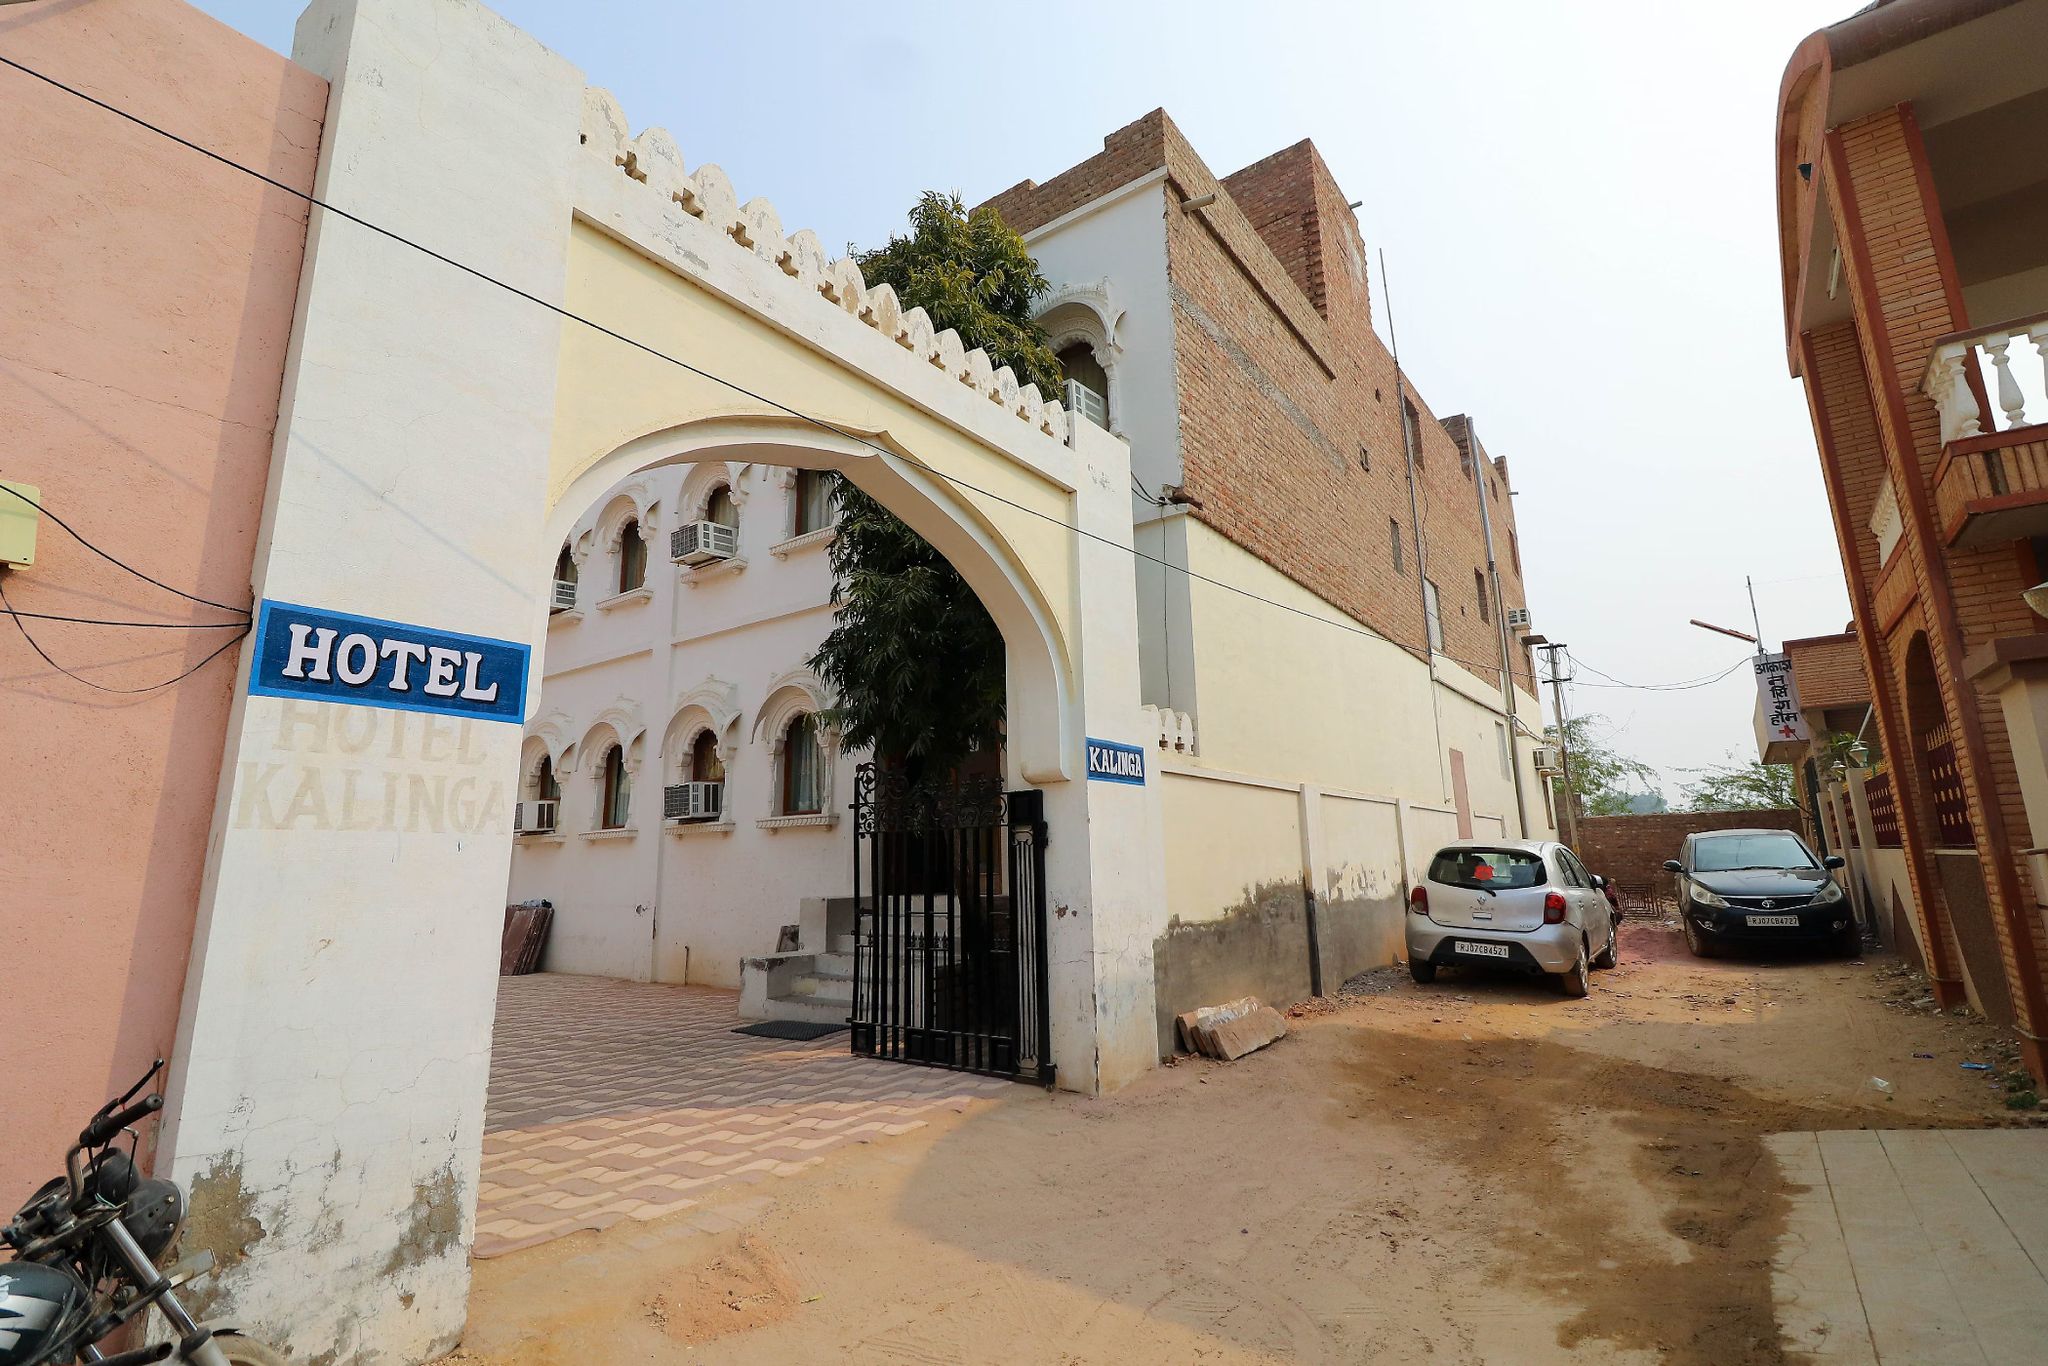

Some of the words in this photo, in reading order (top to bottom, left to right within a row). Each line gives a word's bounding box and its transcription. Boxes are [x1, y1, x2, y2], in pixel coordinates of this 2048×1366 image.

[281, 623, 498, 702] HOTEL
[231, 761, 506, 836] KALINGA
[1088, 746, 1143, 777] KALINGA
